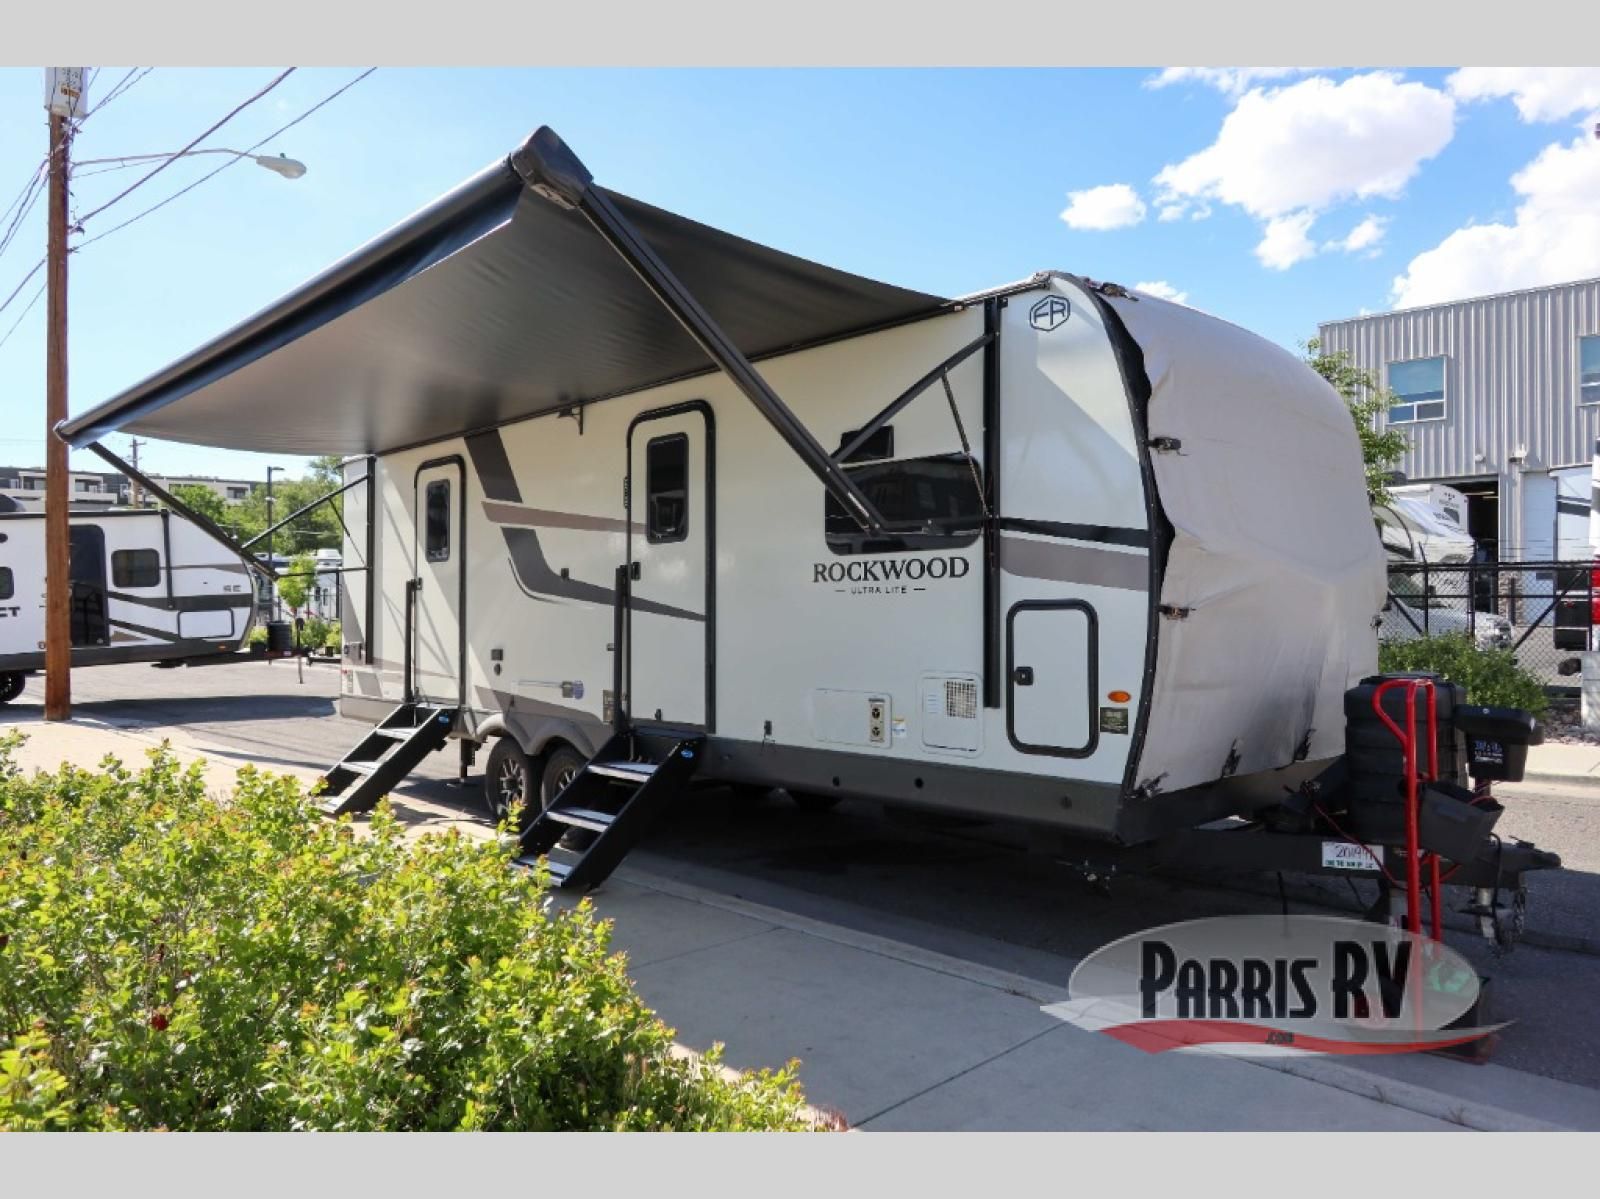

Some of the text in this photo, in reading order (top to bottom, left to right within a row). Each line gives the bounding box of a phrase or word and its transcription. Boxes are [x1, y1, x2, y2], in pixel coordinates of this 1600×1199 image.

[813, 556, 970, 583] ROCKWOOD
[851, 585, 908, 595] ULTRA LITE
